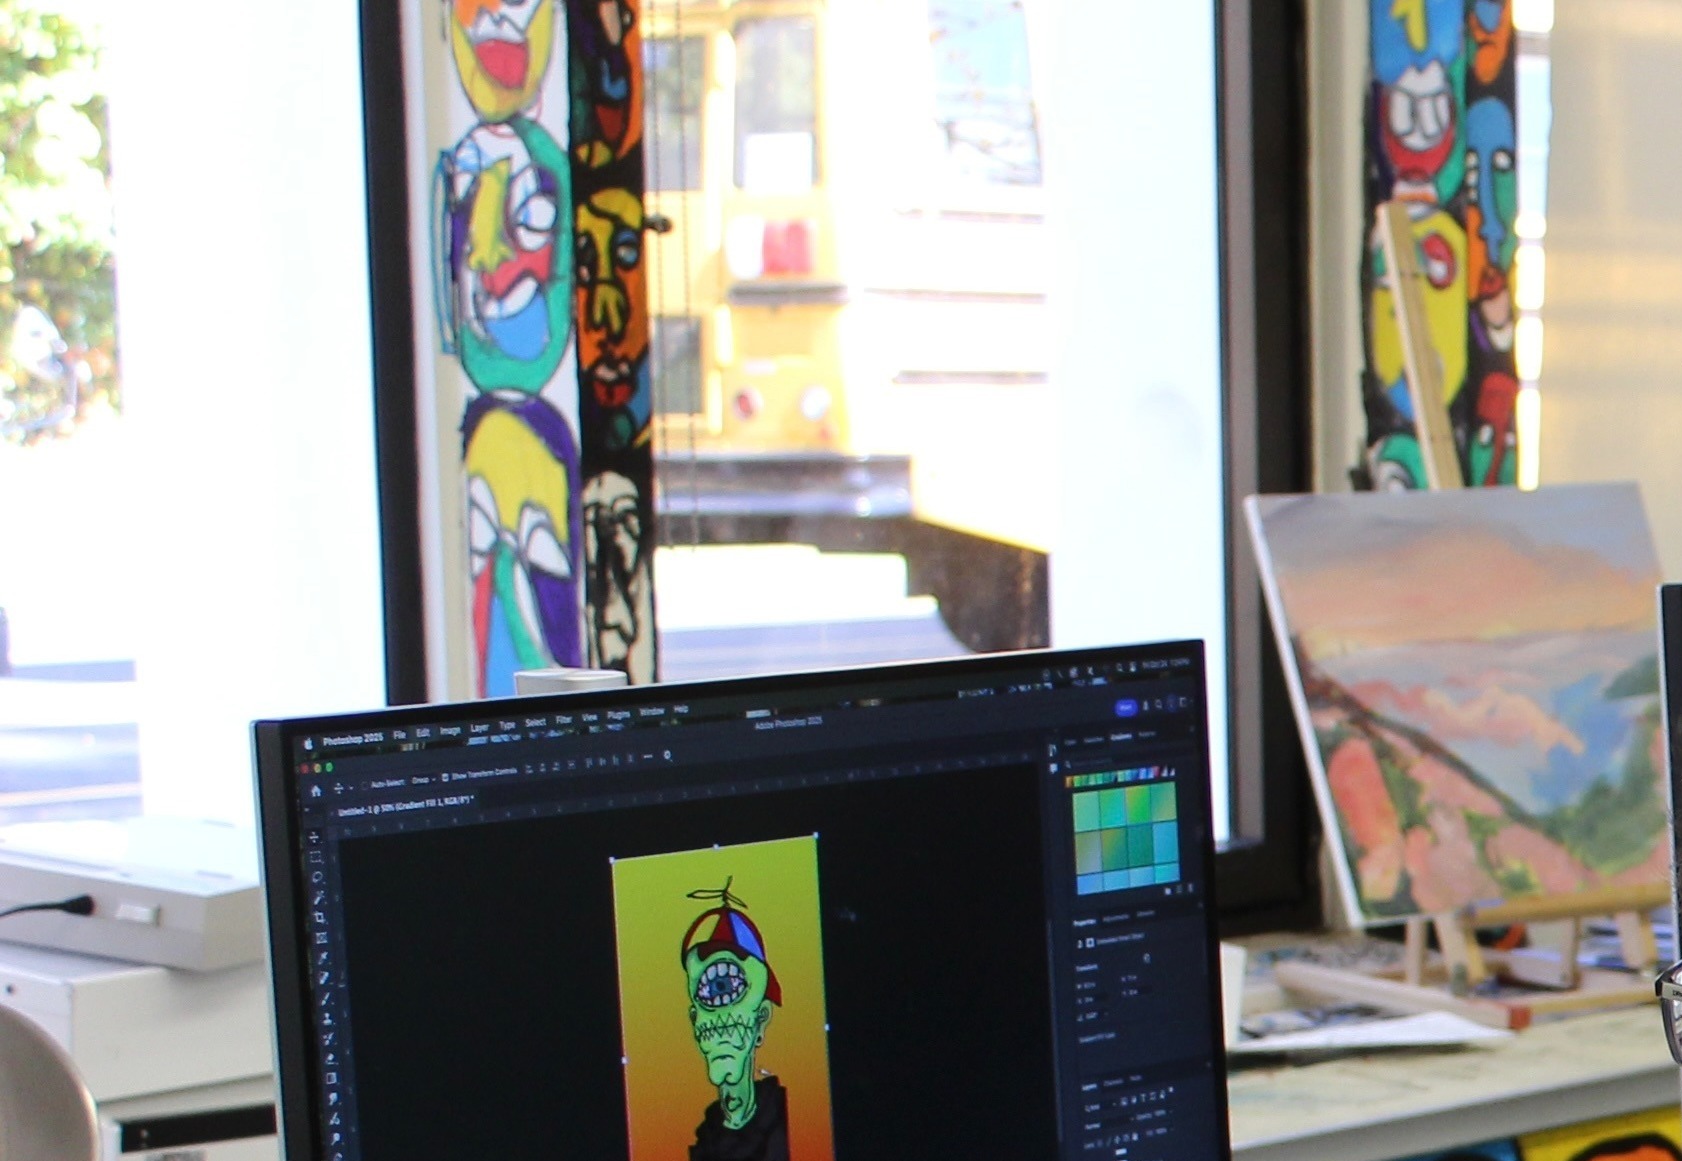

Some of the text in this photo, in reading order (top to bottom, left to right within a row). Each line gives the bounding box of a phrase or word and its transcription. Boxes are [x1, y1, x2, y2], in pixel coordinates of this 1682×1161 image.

[323, 704, 689, 746] Photoshop 2025 File Edit Image Layer Type Select Filter View Plugins Window Help
